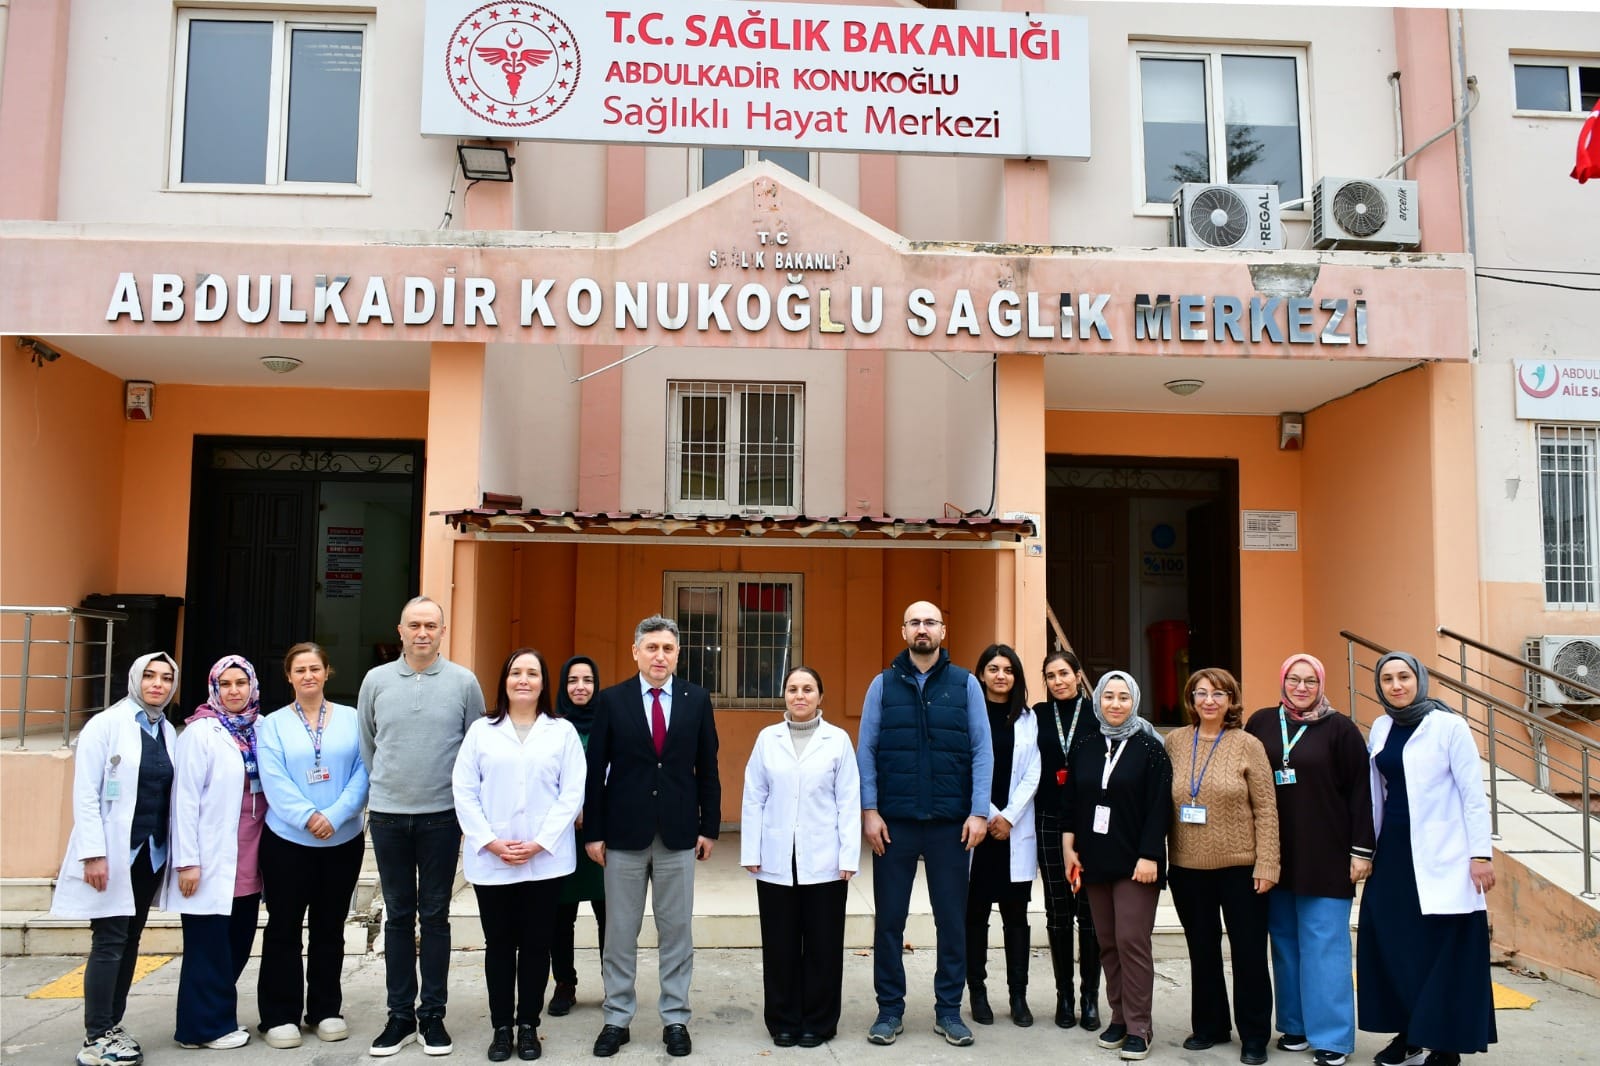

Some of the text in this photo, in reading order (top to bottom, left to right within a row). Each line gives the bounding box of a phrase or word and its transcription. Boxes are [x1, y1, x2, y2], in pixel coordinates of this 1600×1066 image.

[606, 10, 1060, 60] T.C. SAĞLIK BAKANLIĞI
[605, 61, 959, 95] ABDULKADİR KONUKOĞLU
[603, 96, 1000, 139] Sağlıklı Hayat Merkezi
[1258, 192, 1271, 242] REGAL
[1399, 187, 1408, 221] arçelik
[105, 267, 498, 327] ABDULKADİR
[520, 273, 883, 334] KONUKOĞLU
[1562, 368, 1600, 380] ABDUL
[1563, 383, 1600, 397] AİLE S
